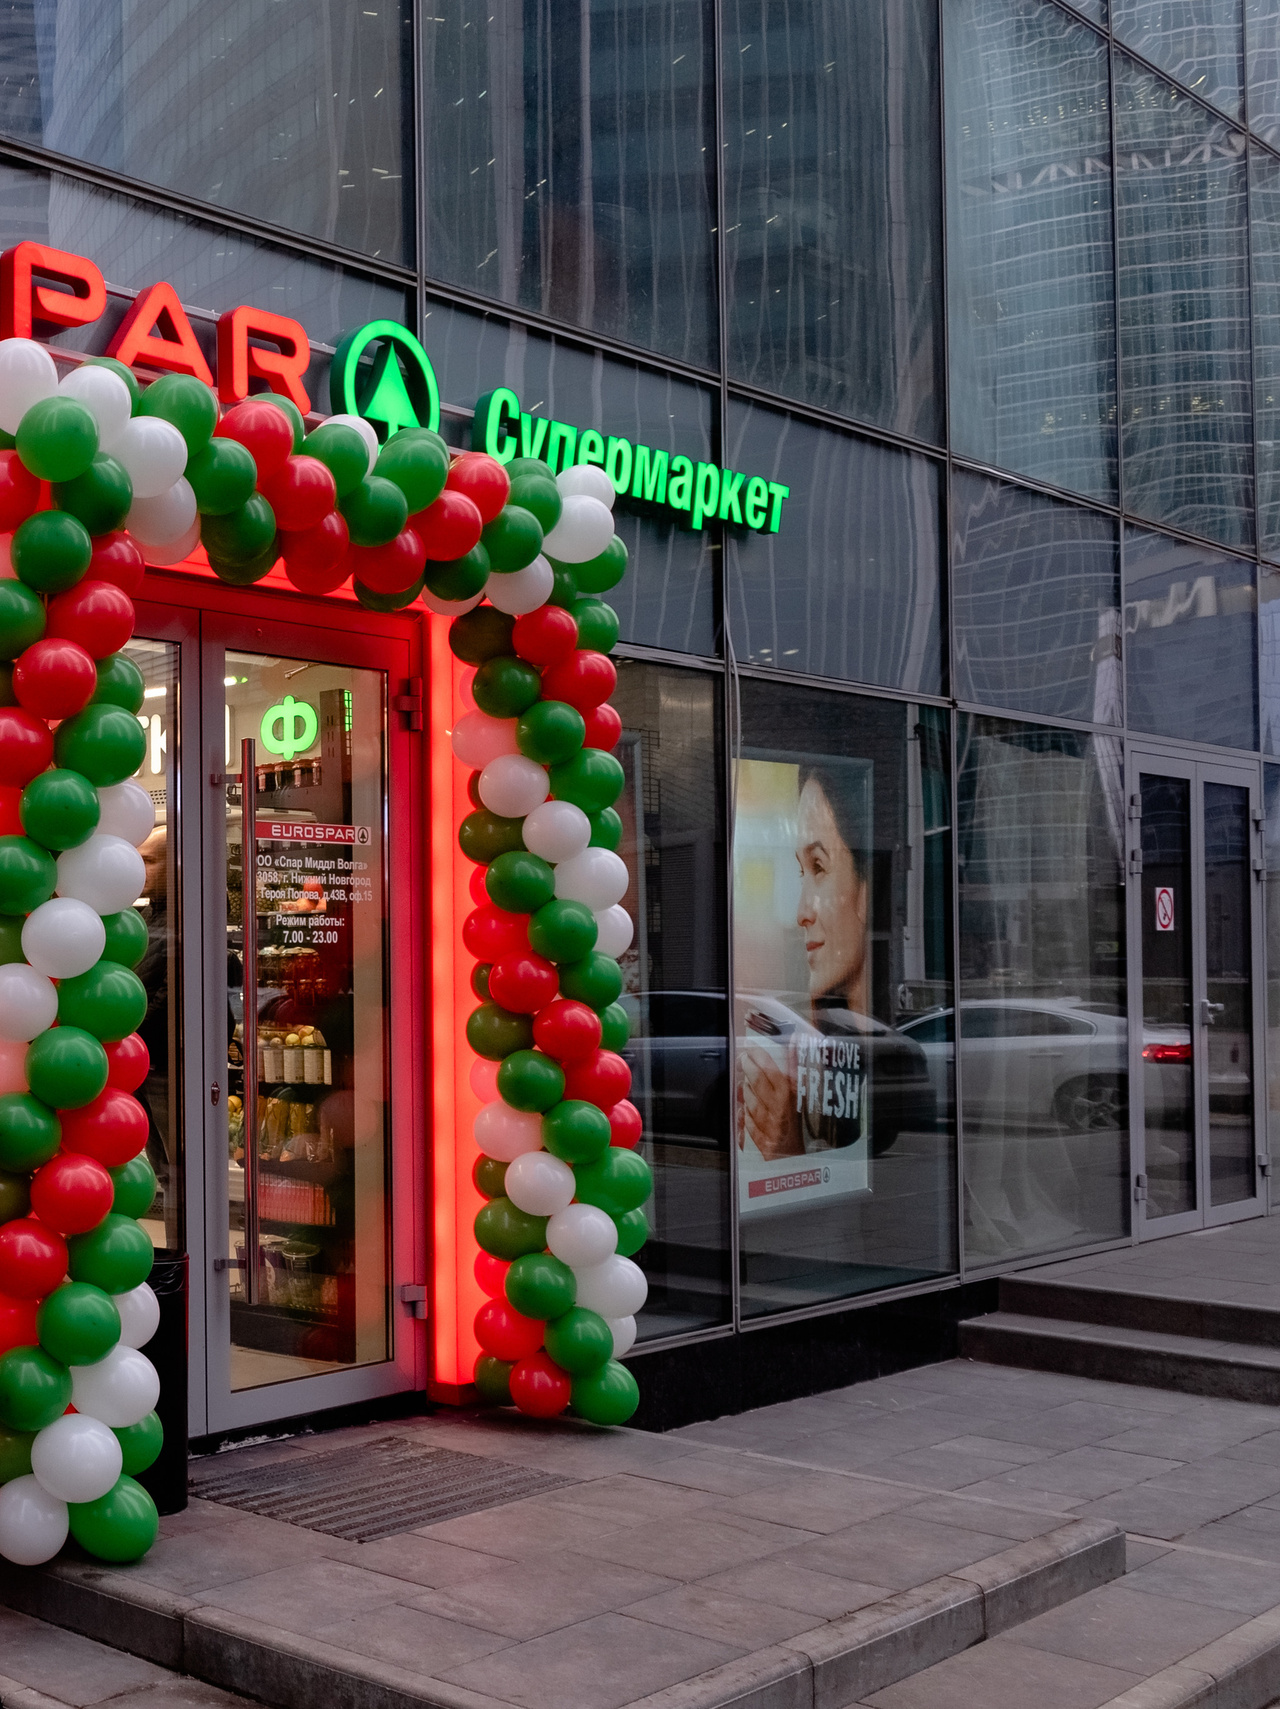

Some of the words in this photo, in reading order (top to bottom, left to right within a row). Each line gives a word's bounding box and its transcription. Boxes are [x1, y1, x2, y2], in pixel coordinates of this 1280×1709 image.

[271, 825, 355, 840] EUROSPAR
[257, 855, 272, 867] ОО
[274, 855, 303, 870] «Спар
[305, 857, 335, 871] Миддл
[337, 858, 368, 870] Волга»
[257, 871, 281, 885] 3058,
[283, 875, 289, 883] г.
[291, 872, 327, 885] Нижний
[328, 874, 372, 888] Новгород
[260, 887, 286, 901] Героя
[287, 888, 321, 900] Попова,
[349, 890, 373, 903] оф.15
[276, 914, 306, 926] Режим
[308, 915, 345, 929] работы:
[283, 930, 304, 943] 7.00
[312, 931, 338, 944] 23.00
[832, 1041, 860, 1070] LOVE
[797, 1066, 860, 1119] FRESH
[764, 1170, 821, 1192] EUROSPAR
